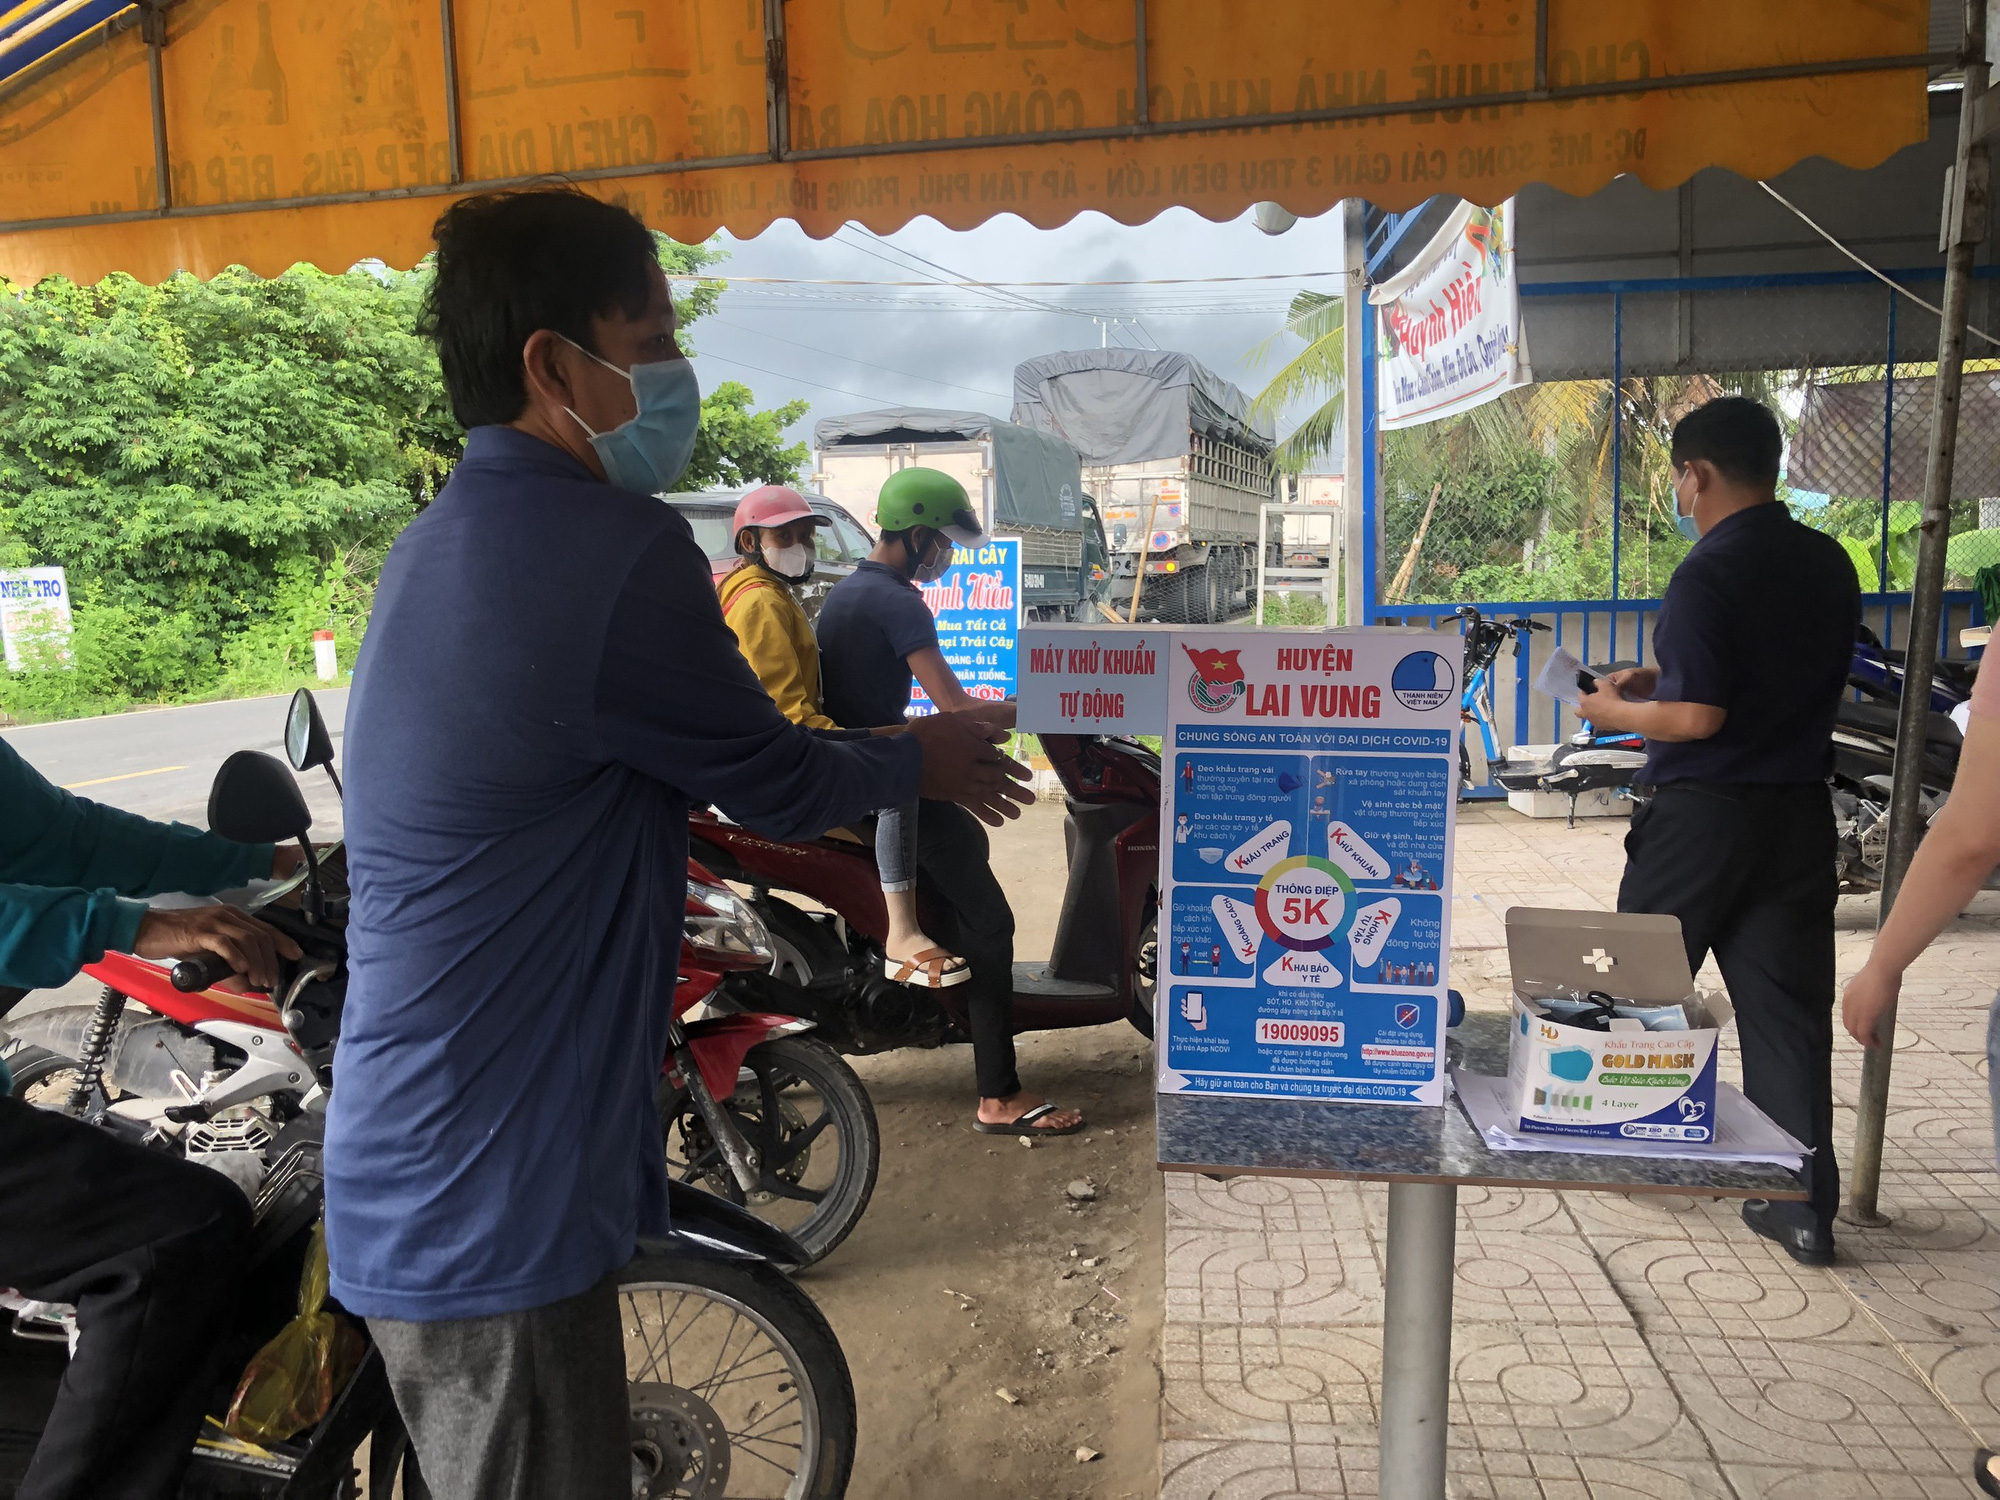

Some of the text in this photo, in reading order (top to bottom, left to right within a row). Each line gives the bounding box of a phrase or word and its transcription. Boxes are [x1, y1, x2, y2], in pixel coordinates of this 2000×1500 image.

[978, 545, 1008, 565] CÂY
[966, 571, 1014, 610] Hiền
[936, 618, 1007, 631] Mua Tất Cả
[938, 636, 1014, 650] oại Trái Cây
[987, 653, 998, 665] LÊ
[1030, 639, 1155, 675] MÁY KHỬ KHUẨN
[1277, 644, 1353, 676] HUYỆN
[1060, 688, 1124, 723] TỰ ĐỘNG
[1246, 684, 1290, 716] LAI
[1300, 684, 1381, 718] VUNG
[1178, 729, 1448, 747] CHUNG SỐNG AN TOÀN VỚI ĐẠI DỊCH COVID-19
[1198, 765, 1214, 773] Đeo
[1216, 764, 1236, 773] khẩu
[1238, 765, 1259, 774] trang
[1226, 794, 1245, 802] trung
[1247, 793, 1266, 802] đông
[1268, 795, 1291, 803] người
[1213, 812, 1232, 821] khẩu
[1235, 814, 1256, 822] trang
[1194, 831, 1236, 840] khu cách ly
[1260, 830, 1290, 853] TRANG
[1276, 882, 1339, 897] THÔNG ĐIỆP
[1223, 897, 1238, 919] CÁCH
[1283, 897, 1329, 925] 5K
[1363, 910, 1392, 945] KHÔNG
[1411, 919, 1440, 929] Không
[1414, 930, 1439, 939] tụ tập
[1386, 939, 1439, 949] đông người
[1282, 957, 1329, 973] KHAI BÁO
[1262, 1023, 1338, 1042] 19009095
[1605, 1039, 1694, 1050] Khẩu Trang Cao Cấp
[1602, 1053, 1695, 1069] GOLD MASK
[1195, 1077, 1208, 1089] Hãy
[1210, 1079, 1222, 1090] giữ
[1234, 1079, 1249, 1089] toàn
[1251, 1080, 1263, 1090] cho
[1266, 1080, 1279, 1092] Bạn
[1281, 1081, 1289, 1091] và
[1291, 1081, 1312, 1094] chúng
[1314, 1084, 1320, 1092] ta
[1343, 1083, 1354, 1096] đại
[1356, 1084, 1371, 1097] dịch
[1373, 1086, 1407, 1097] COVID-19
[1612, 1100, 1639, 1109] Layer
